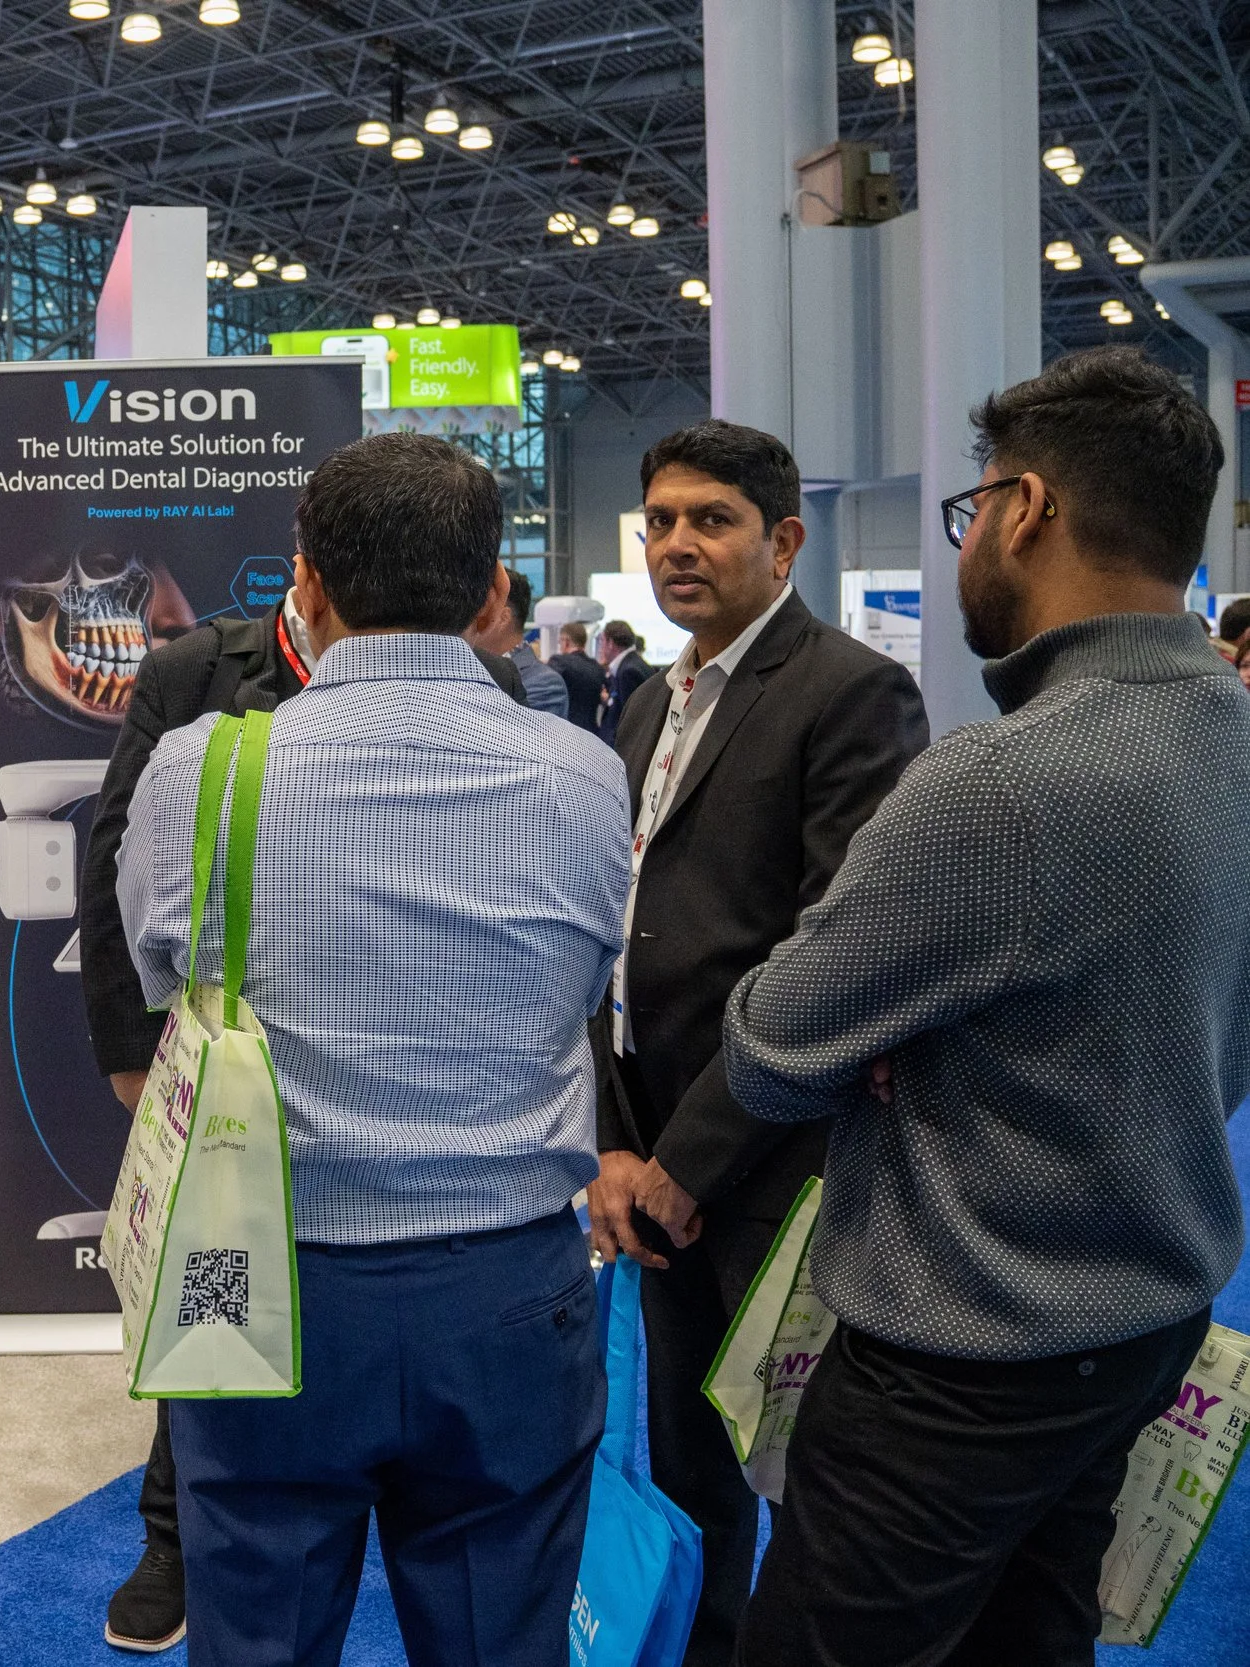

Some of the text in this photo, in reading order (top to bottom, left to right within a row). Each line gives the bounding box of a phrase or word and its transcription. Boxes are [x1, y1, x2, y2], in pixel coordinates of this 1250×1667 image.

[409, 337, 446, 355] Fast.
[409, 357, 479, 379] Friendly.
[409, 378, 449, 400] Easy.
[63, 379, 257, 424] Vision
[17, 431, 305, 459] The Ultimate Solution for
[111, 466, 186, 490] Dental
[87, 504, 235, 521] Powered by RAY AI Lab!
[247, 572, 284, 587] Face
[1151, 1422, 1176, 1440] WAY
[1216, 1439, 1231, 1453] No
[1151, 1458, 1175, 1503] SHINE BRIGHTER
[1206, 1463, 1226, 1478] WITH
[1166, 1499, 1185, 1518] The
[1143, 1577, 1154, 1591] THE
[1152, 1526, 1176, 1577] DIFFERENCE
